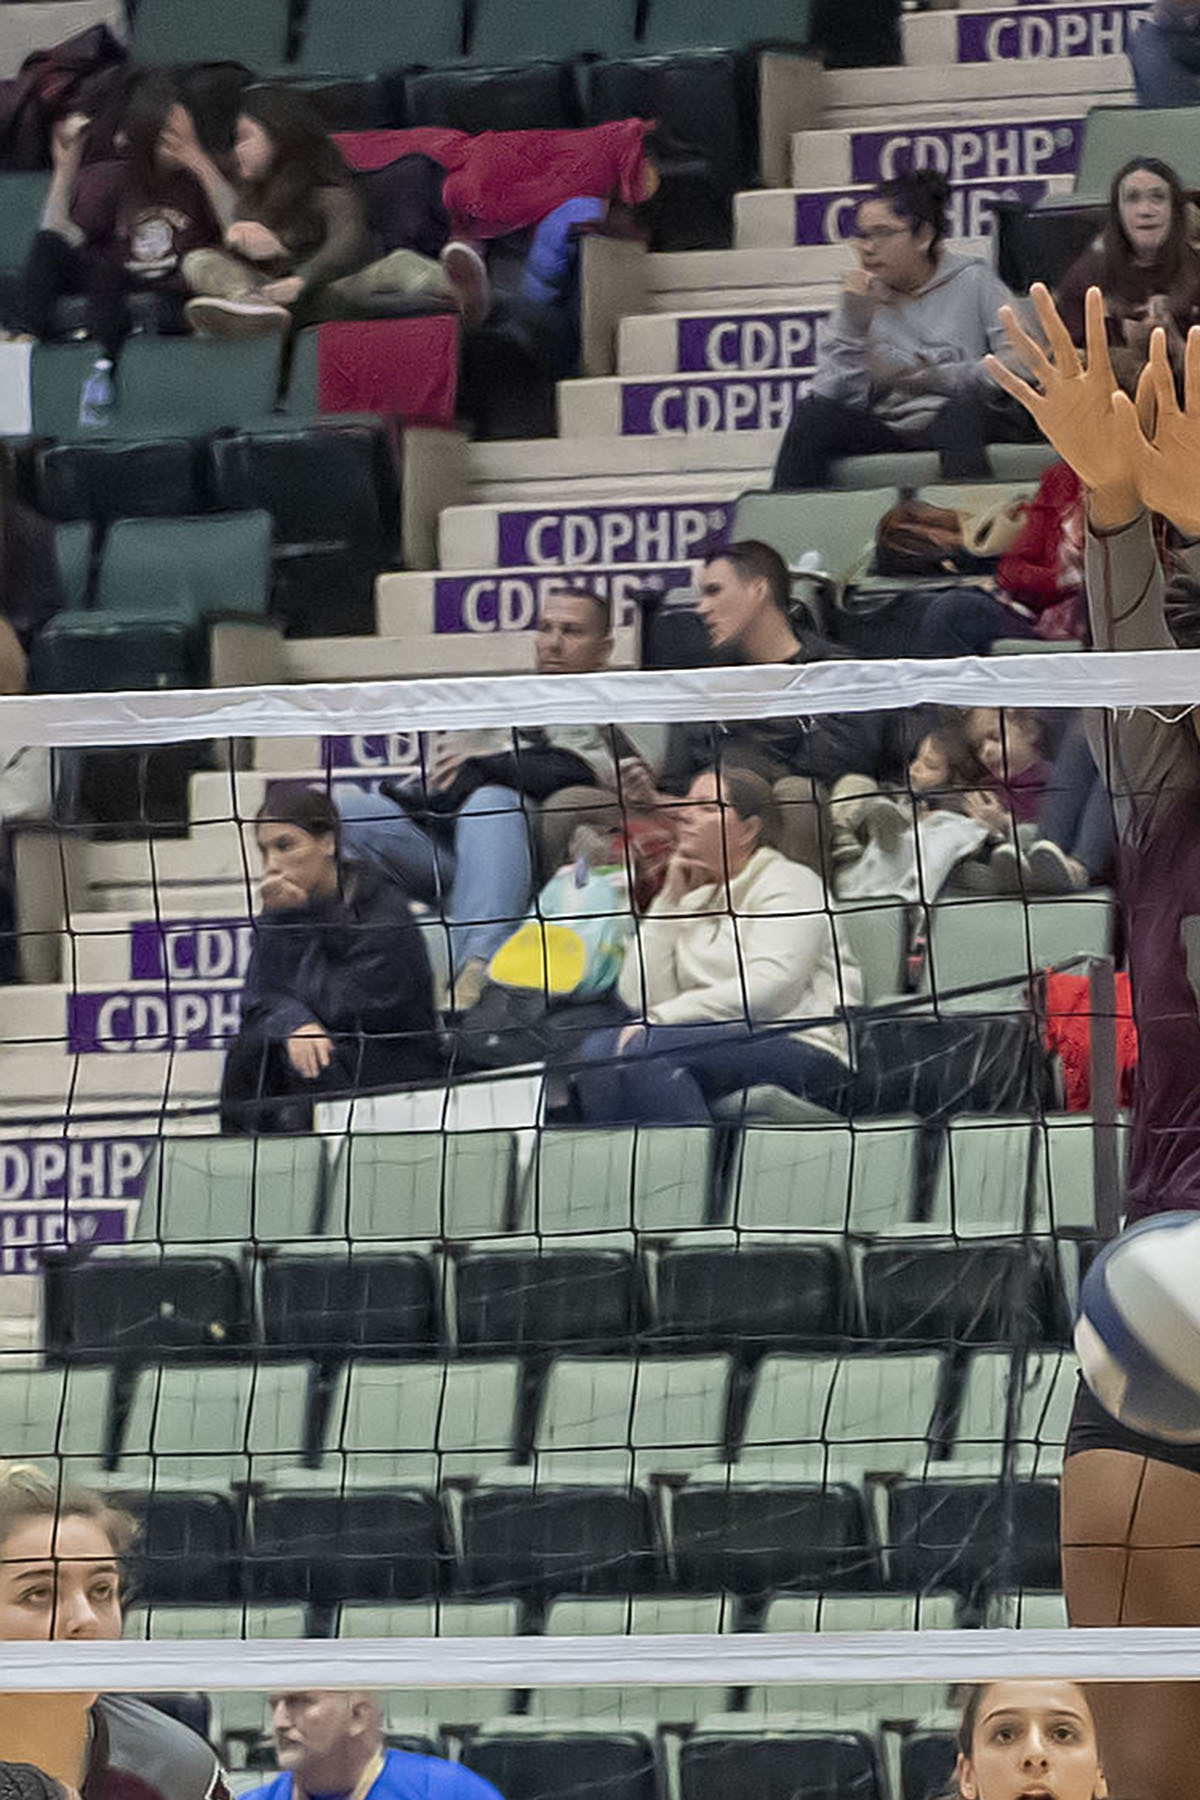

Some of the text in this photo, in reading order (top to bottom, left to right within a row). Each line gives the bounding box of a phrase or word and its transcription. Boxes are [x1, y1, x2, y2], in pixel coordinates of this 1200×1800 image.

[986, 11, 1152, 62] CDPH
[707, 320, 822, 372] CDP
[652, 381, 813, 434] CDPH
[525, 510, 708, 565] CDPHP
